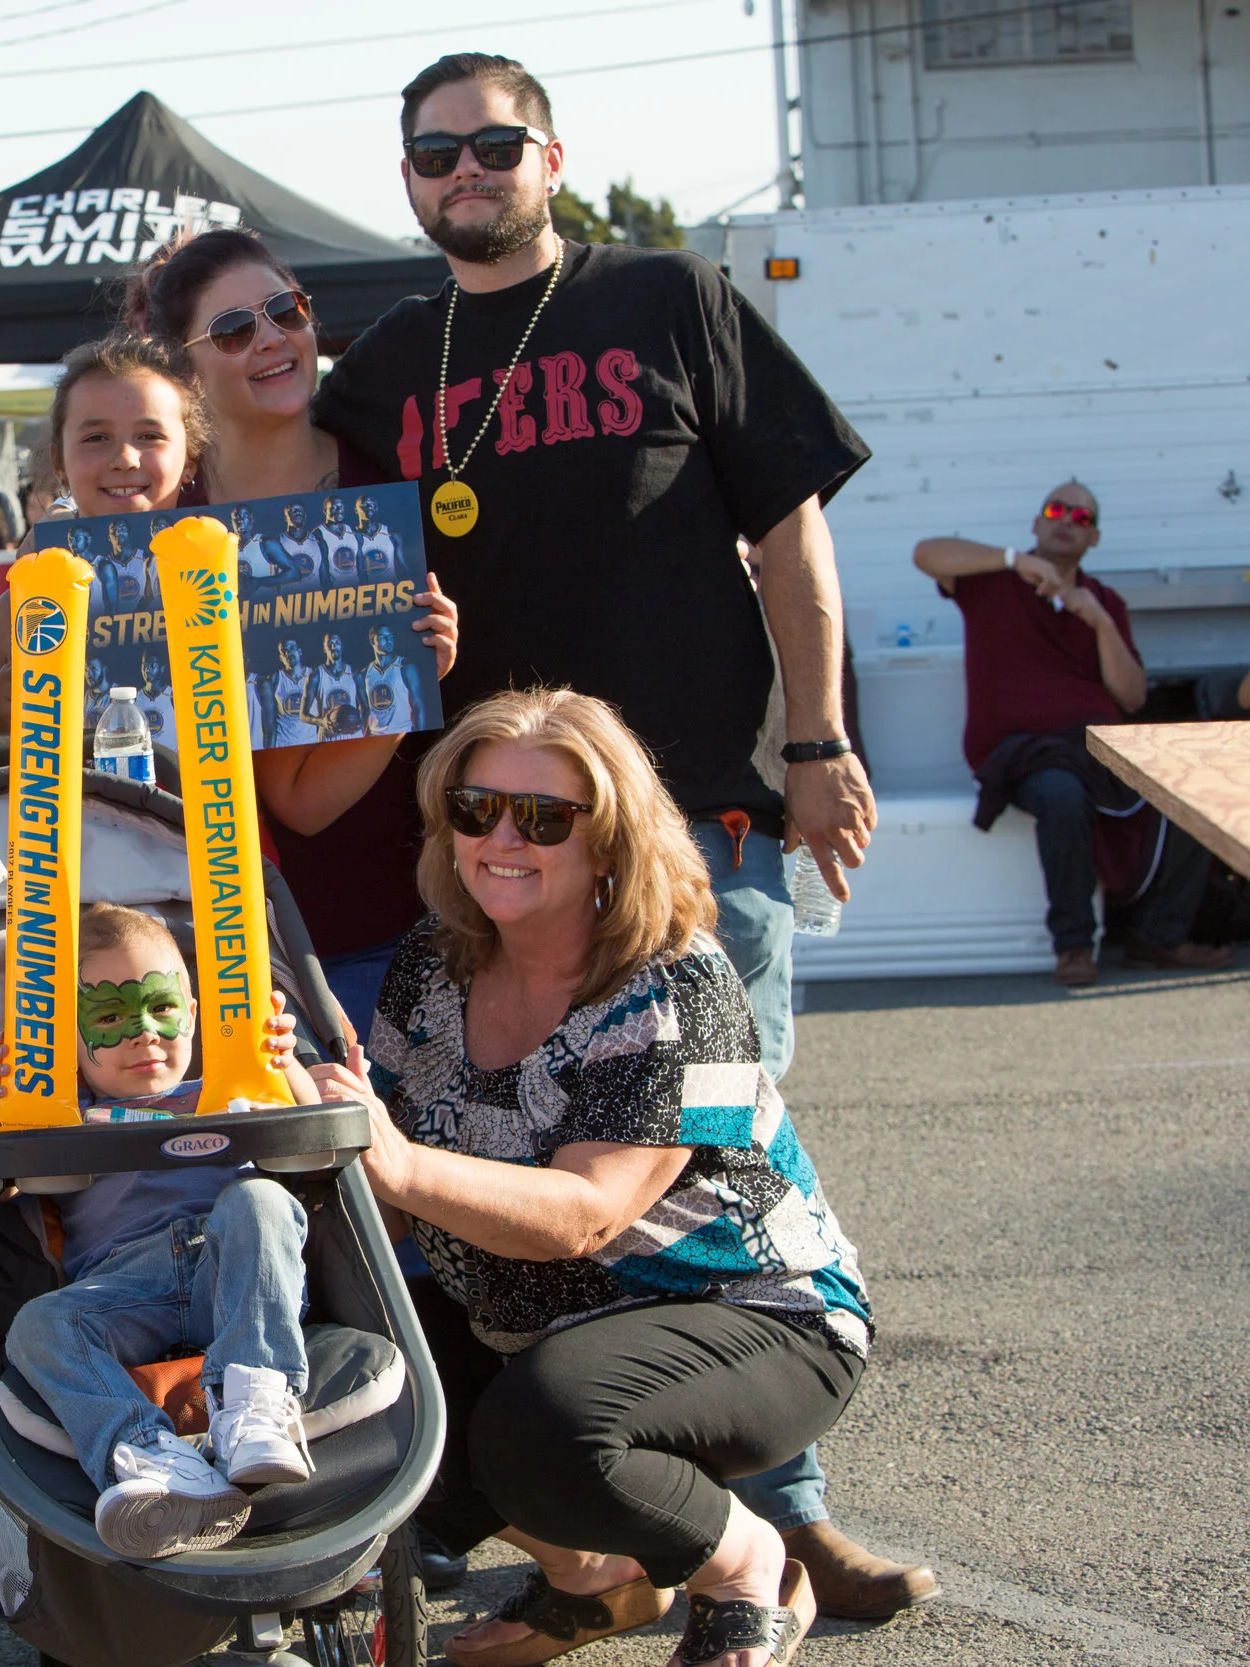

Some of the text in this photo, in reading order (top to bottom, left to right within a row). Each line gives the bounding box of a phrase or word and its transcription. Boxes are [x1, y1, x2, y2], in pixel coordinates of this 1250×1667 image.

[8, 187, 241, 230] CHARLES
[435, 498, 471, 514] PACIFICO
[252, 602, 271, 625] IN
[274, 580, 416, 628] NUMBERS
[18, 669, 62, 878] STRENGTH
[7, 841, 15, 866] 2017
[188, 644, 252, 1023] KAISER PERMANENTE
[24, 879, 51, 906] IN
[14, 908, 57, 1097] NUMBERS
[170, 1137, 224, 1152] GRACO
